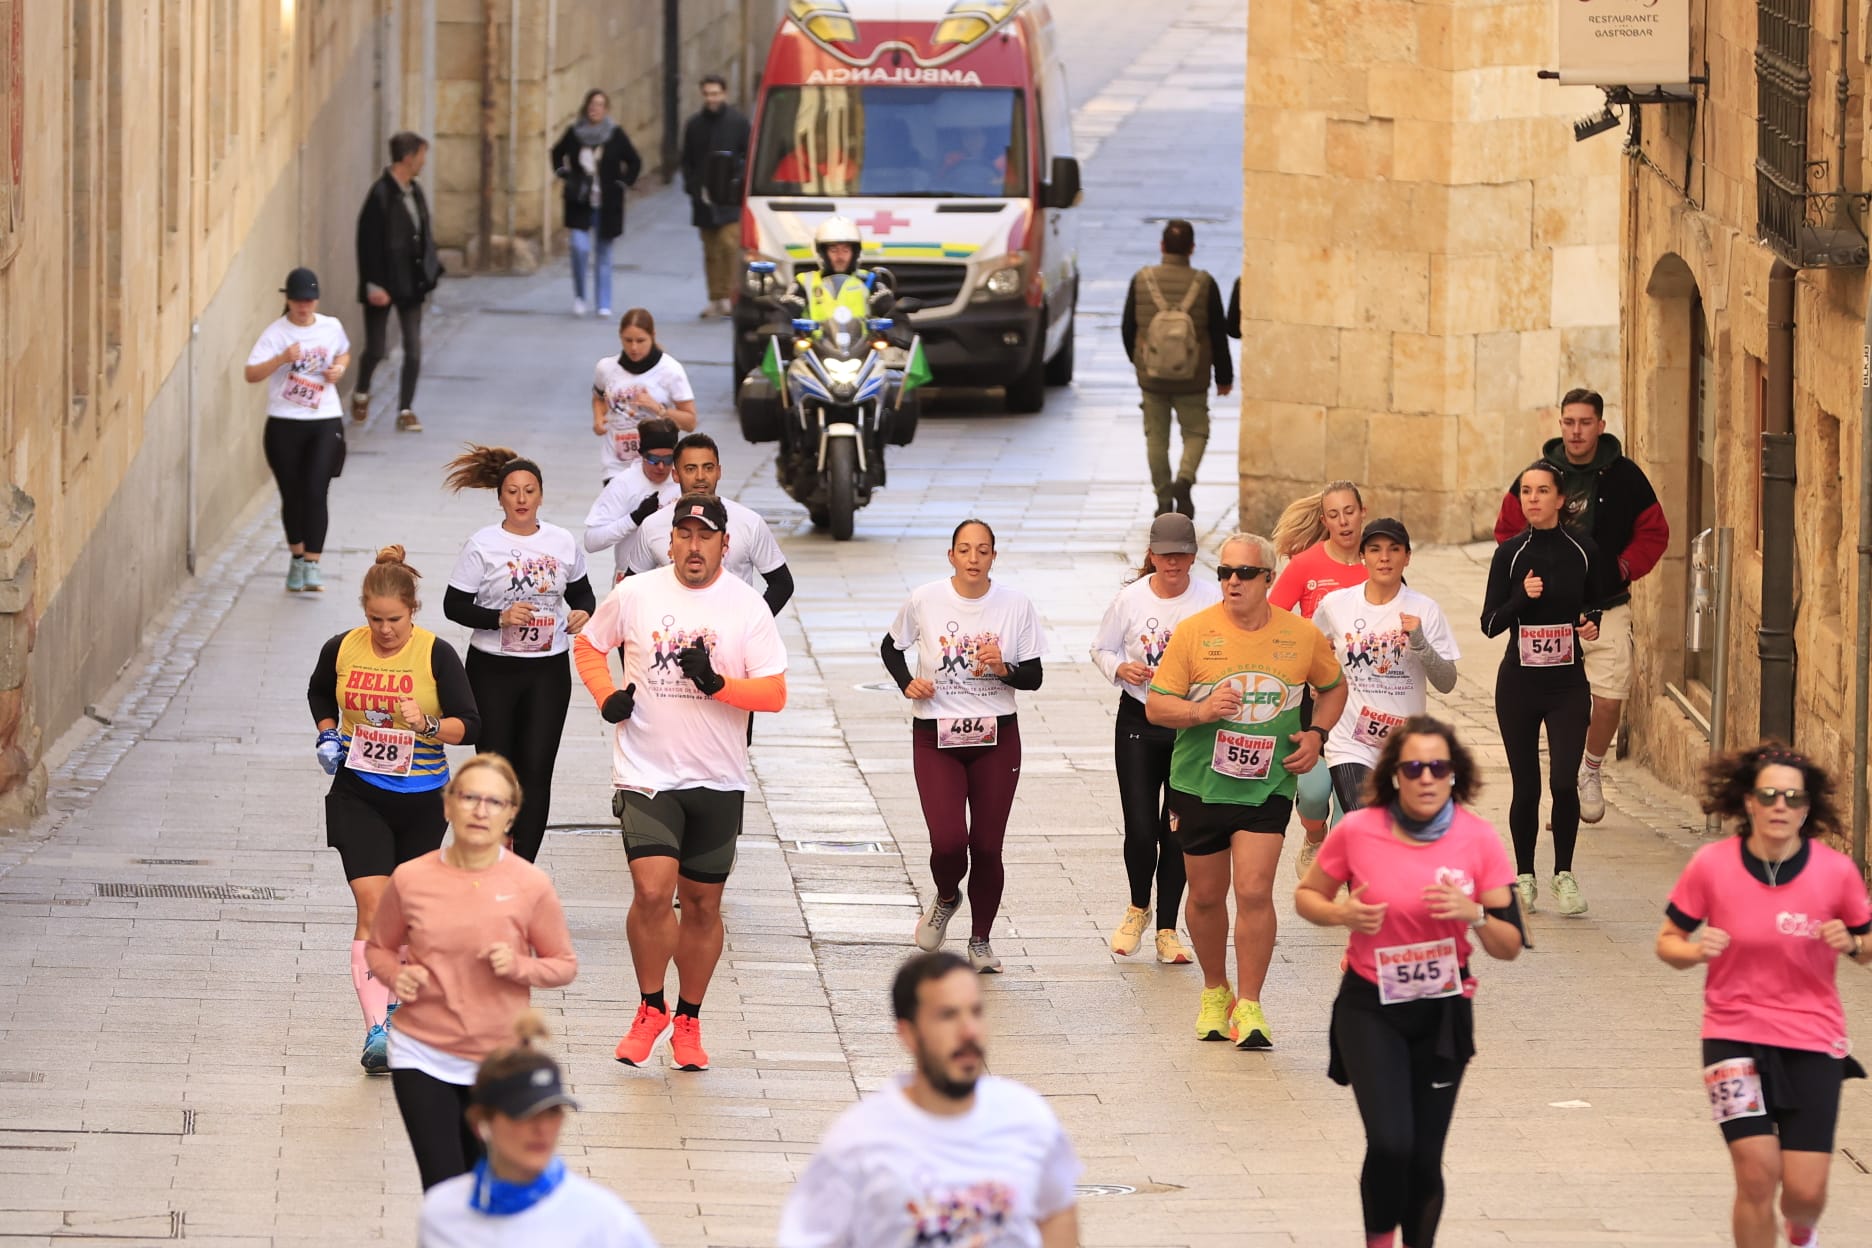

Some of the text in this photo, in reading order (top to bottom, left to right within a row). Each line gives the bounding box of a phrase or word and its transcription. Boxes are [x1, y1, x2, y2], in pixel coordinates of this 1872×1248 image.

[1588, 14, 1660, 24] RESTAURANTE
[1595, 28, 1653, 38] GASTROBAR
[623, 441, 640, 453] 38
[519, 627, 539, 642] 73
[1521, 627, 1572, 638] bedunia
[1532, 638, 1561, 654] 541
[346, 670, 413, 693] HELLO
[951, 718, 984, 734] 484
[1368, 721, 1389, 738] 56
[355, 725, 413, 745] bedunia
[1218, 731, 1273, 750] bedunia
[363, 741, 398, 761] 228
[1228, 746, 1259, 765] 556
[1397, 960, 1441, 983] 545
